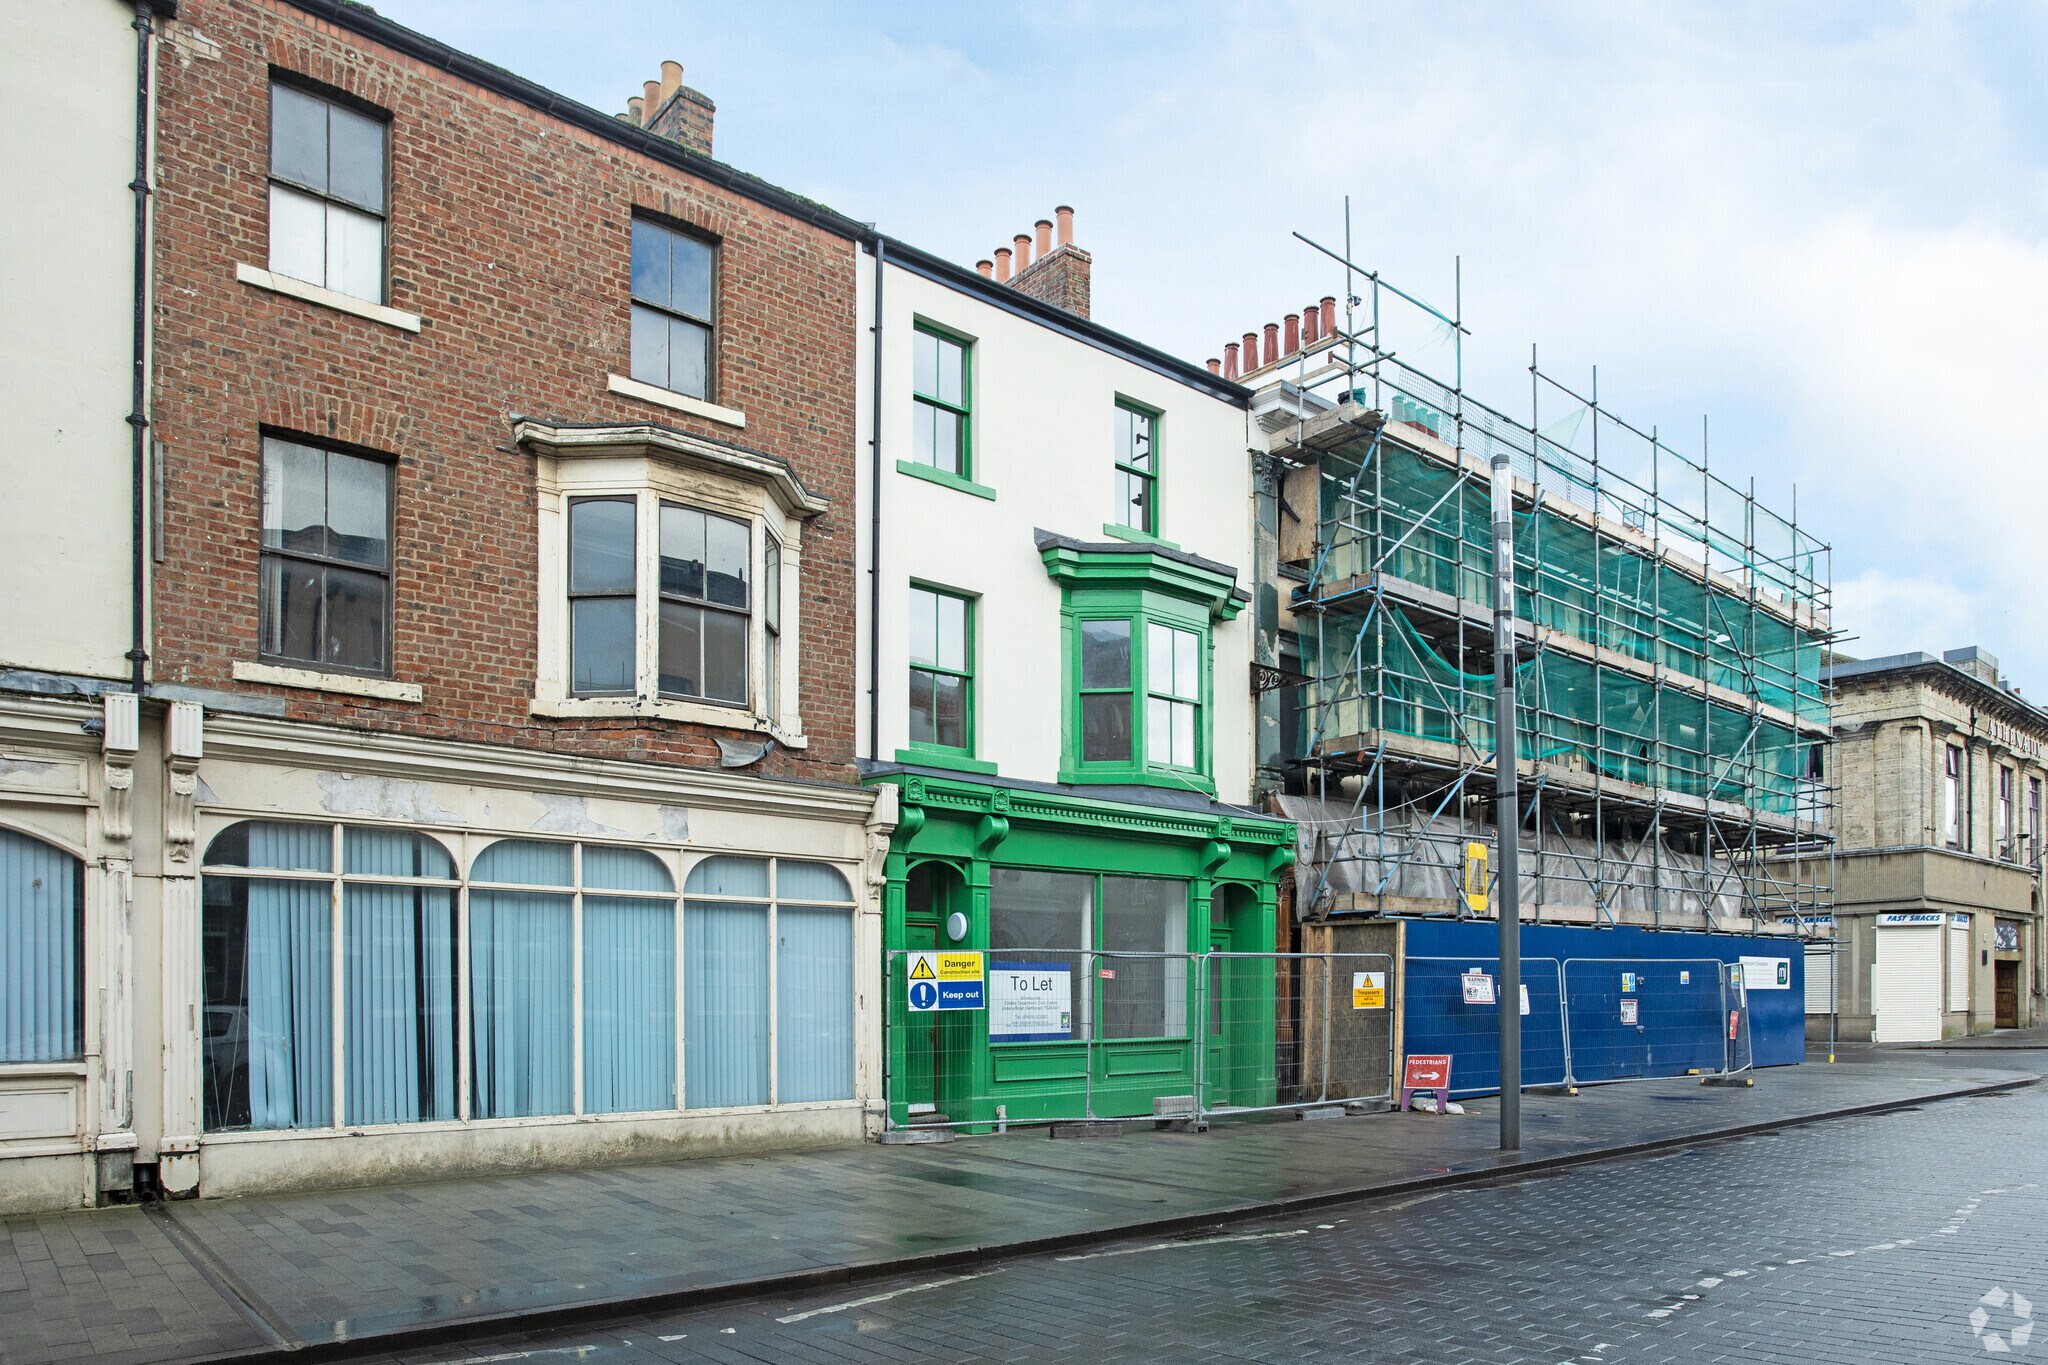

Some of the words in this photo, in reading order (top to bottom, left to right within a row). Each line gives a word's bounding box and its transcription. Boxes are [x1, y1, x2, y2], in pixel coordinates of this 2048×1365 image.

[944, 960, 975, 968] Danger
[1011, 976, 1027, 991] To
[1033, 976, 1053, 991] Let
[943, 991, 963, 999] Keep
